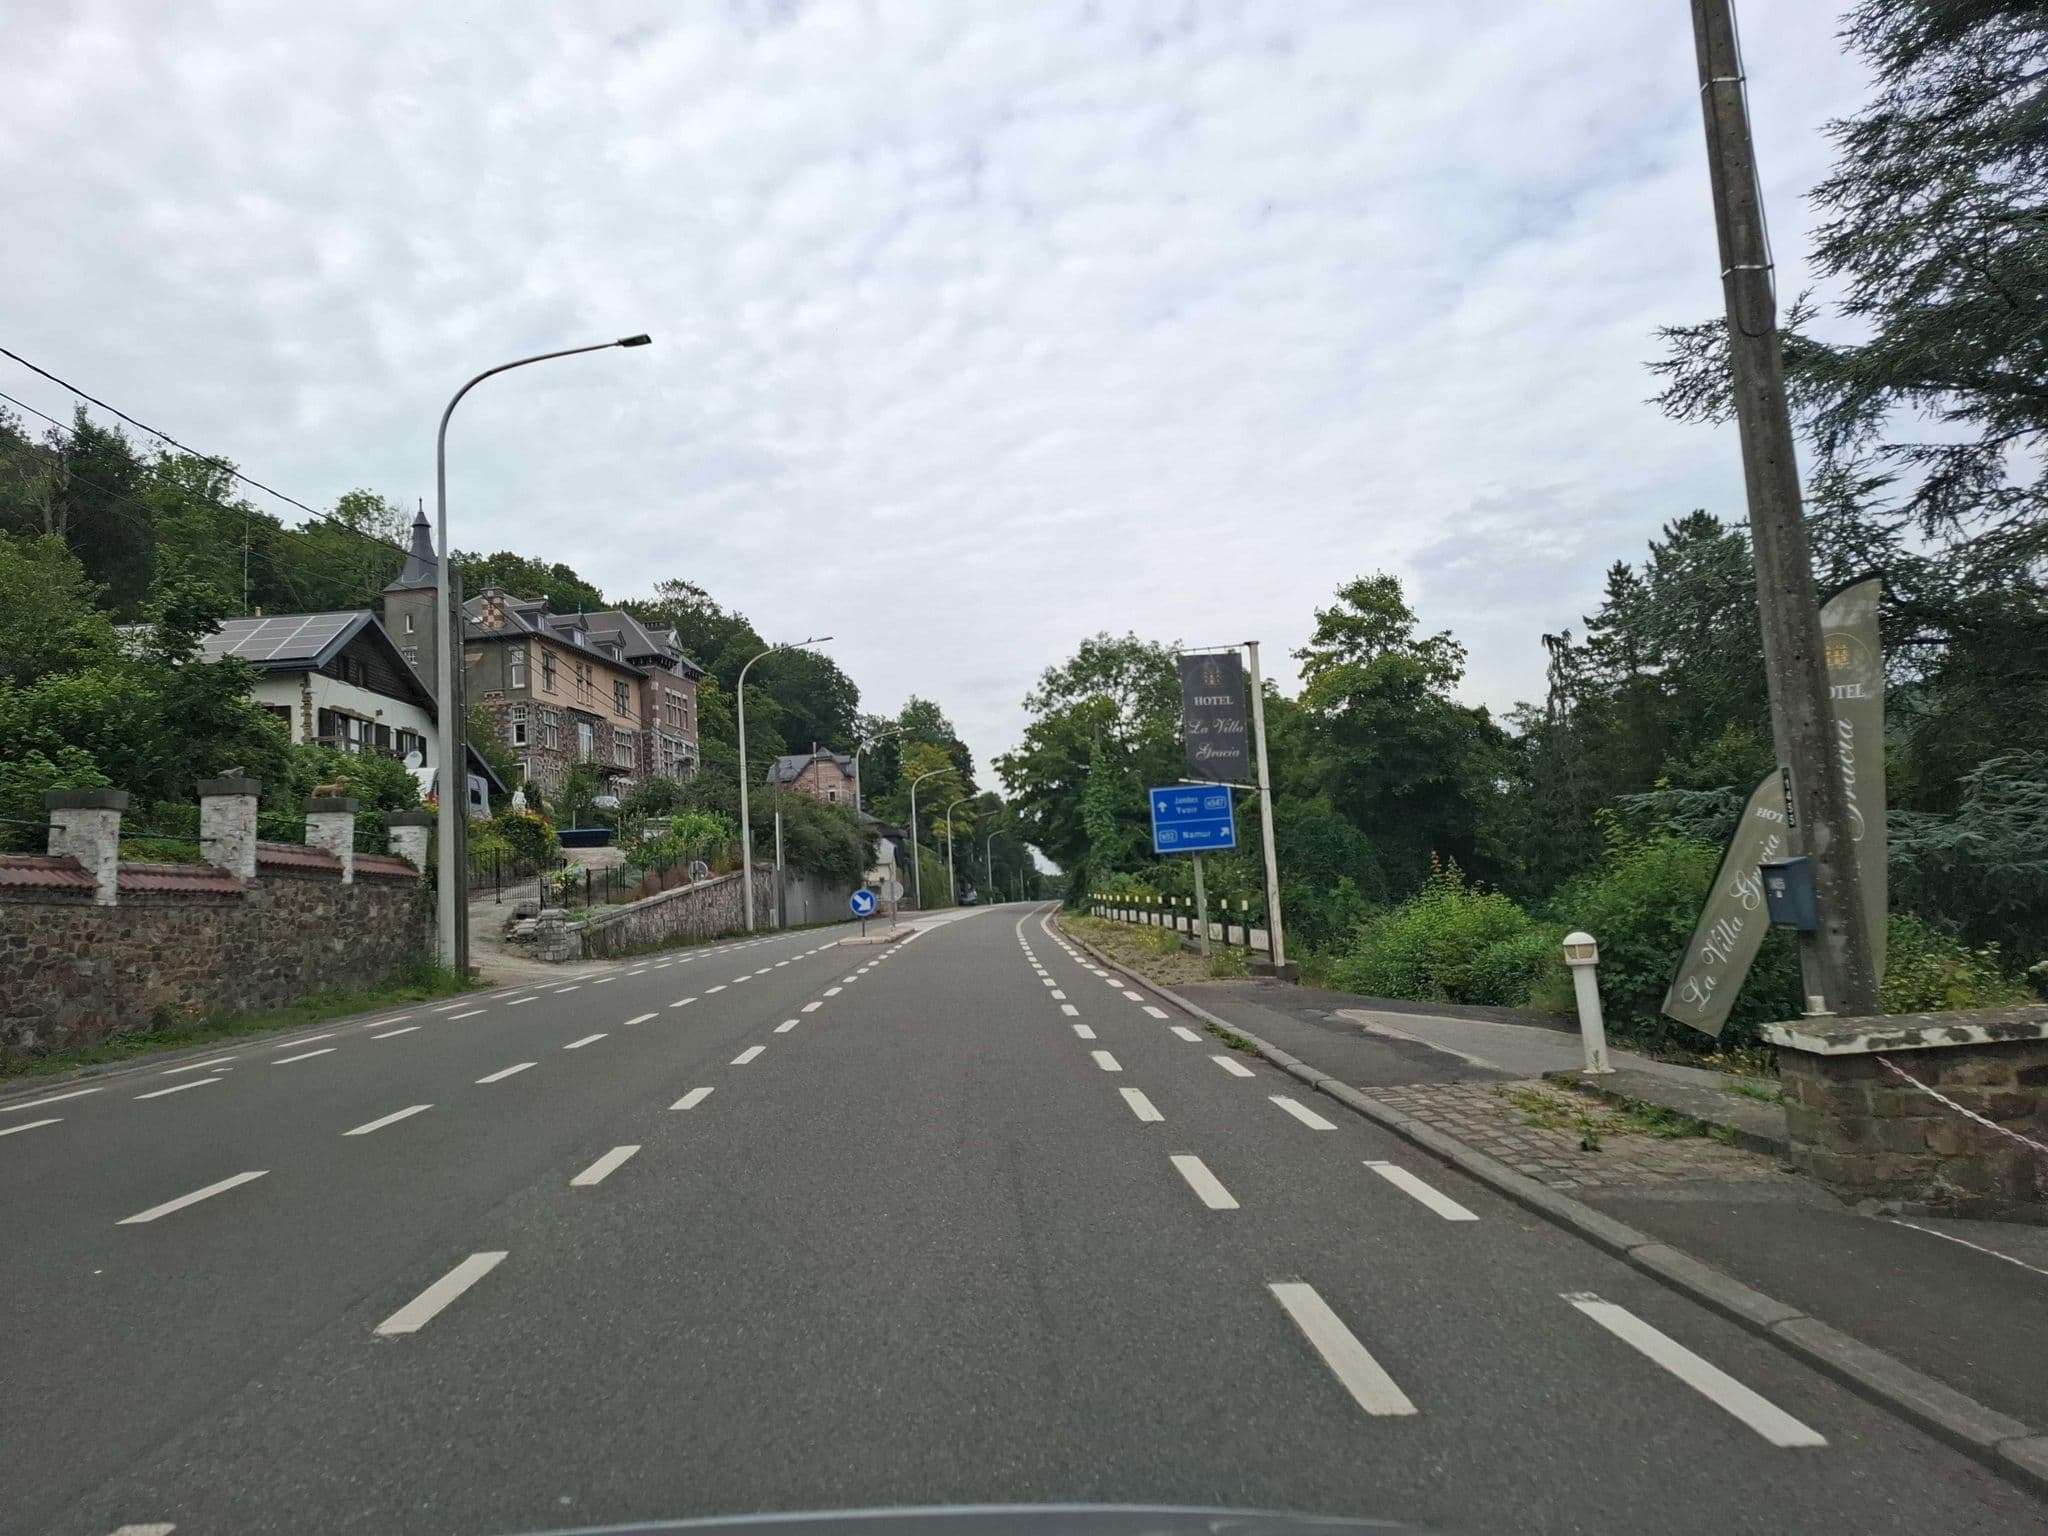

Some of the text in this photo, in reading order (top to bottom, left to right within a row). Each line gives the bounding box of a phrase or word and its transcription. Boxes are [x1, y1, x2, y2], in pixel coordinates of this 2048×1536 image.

[1193, 695, 1234, 706] HOTEL
[1188, 718, 1244, 734] La Villa
[1195, 743, 1240, 760] Gracia
[1755, 807, 1785, 824] HOT
[1182, 831, 1211, 840] Namur
[1681, 974, 1717, 1012] La
[1700, 915, 1743, 964] Villa
